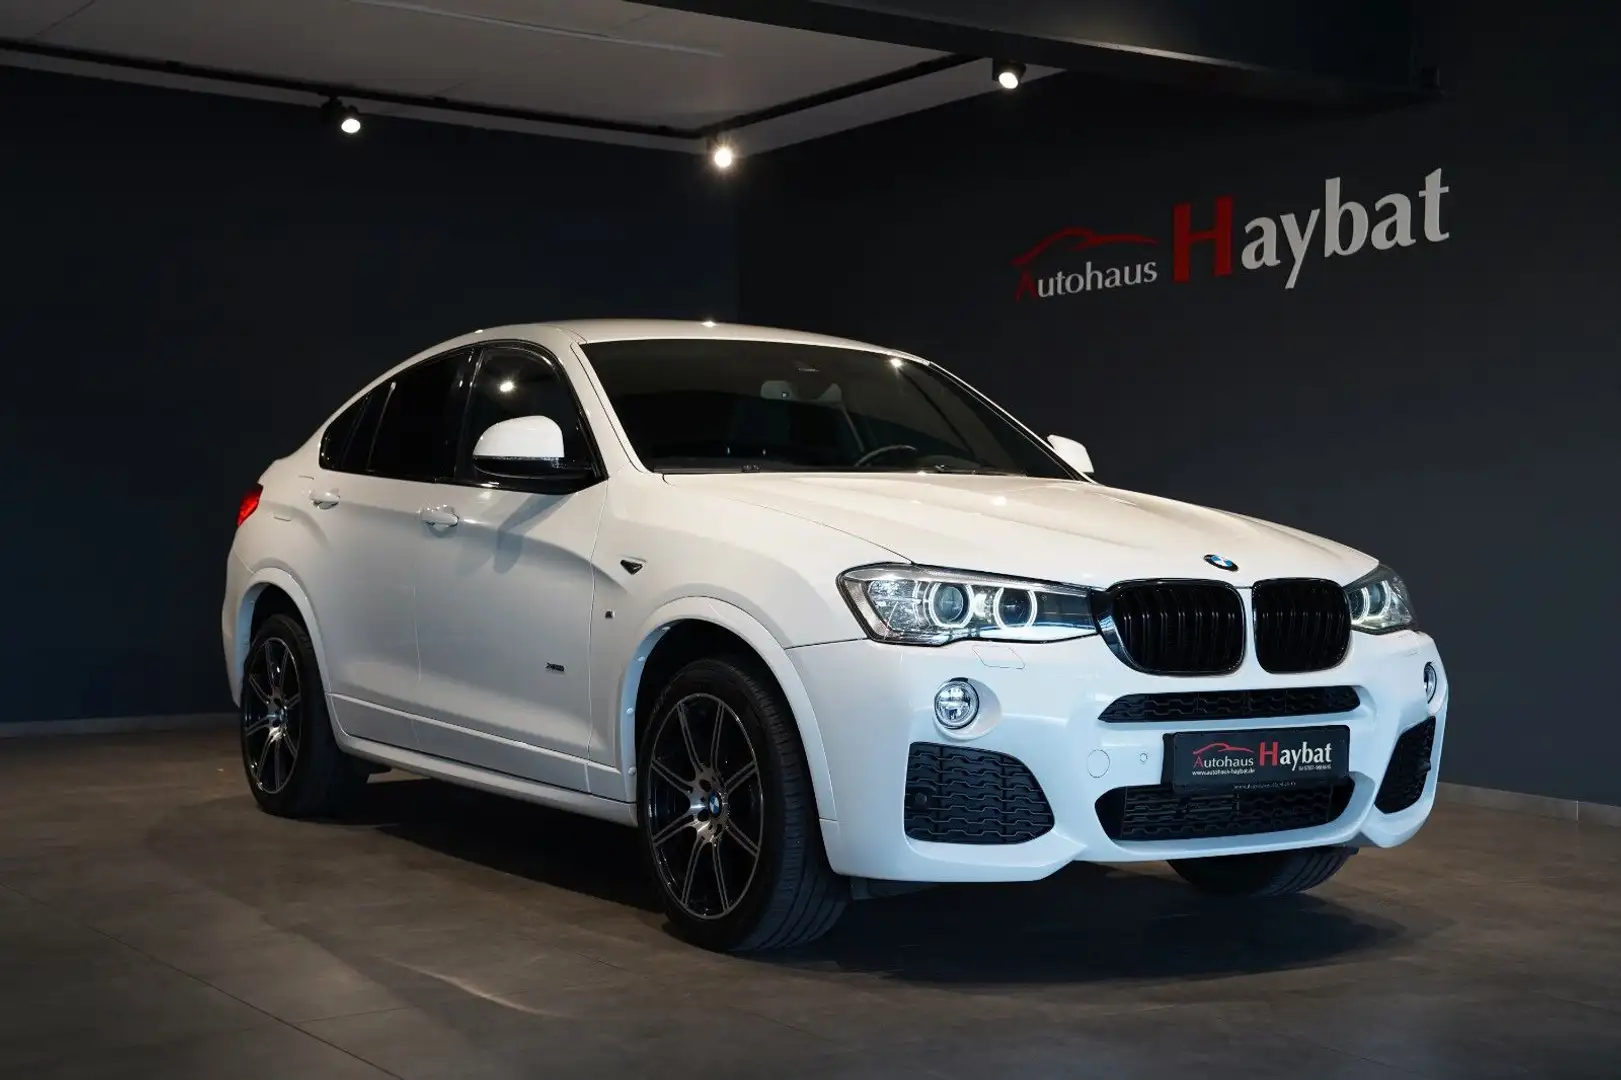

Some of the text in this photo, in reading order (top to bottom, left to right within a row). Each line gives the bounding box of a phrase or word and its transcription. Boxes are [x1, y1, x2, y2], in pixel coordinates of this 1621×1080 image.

[1016, 168, 1449, 300] Autohaus Haybat
[1194, 741, 1332, 772] Autohaus Haybat
